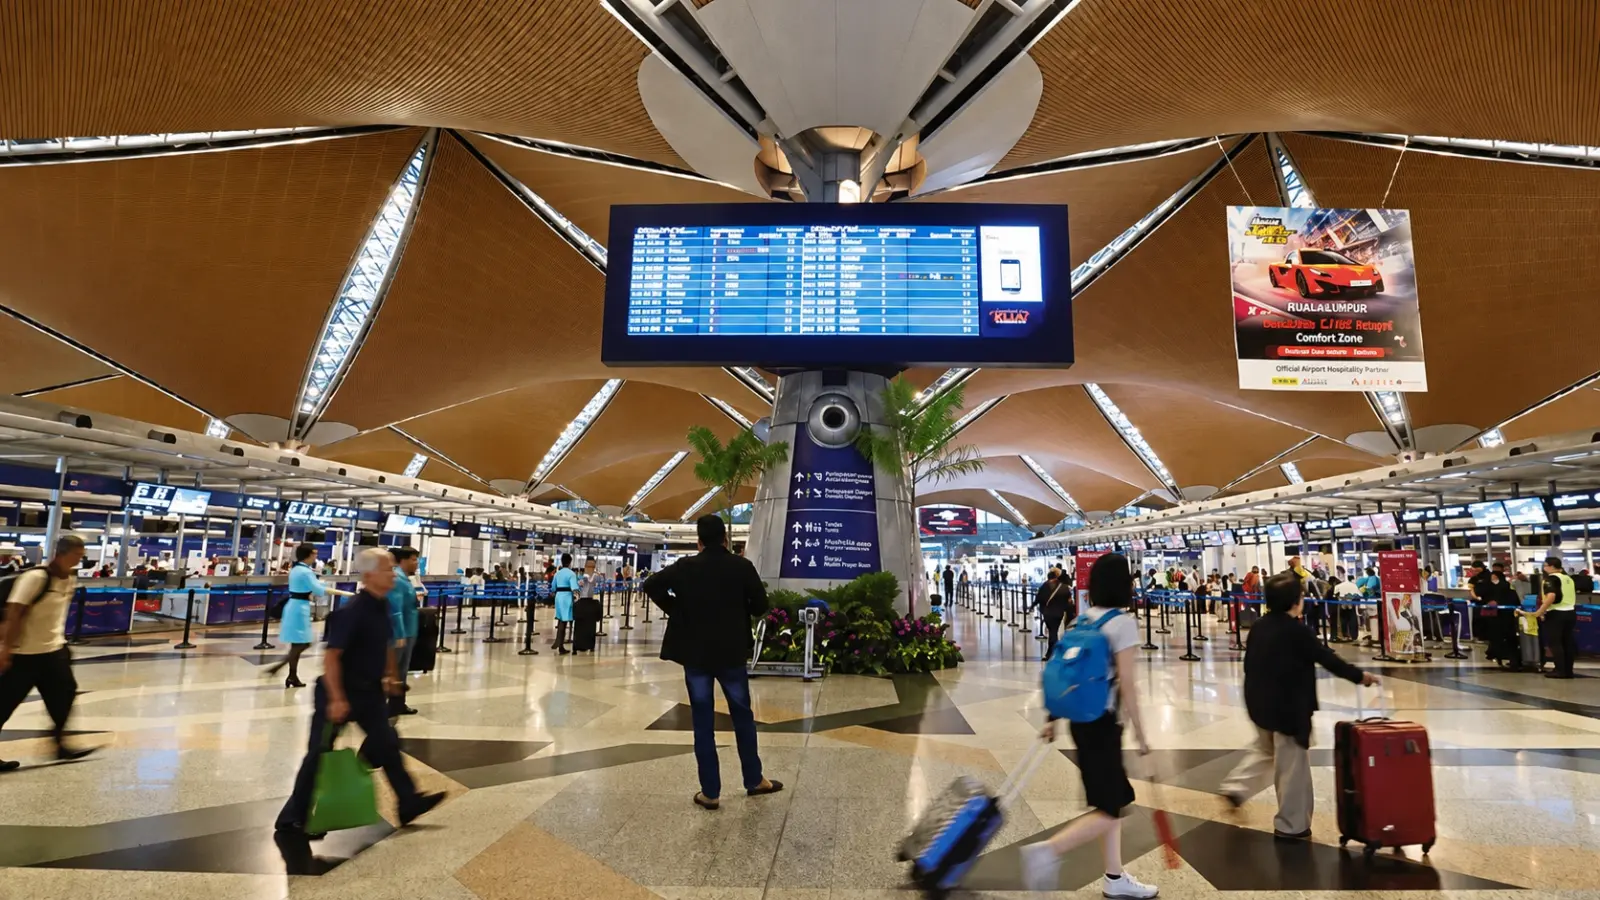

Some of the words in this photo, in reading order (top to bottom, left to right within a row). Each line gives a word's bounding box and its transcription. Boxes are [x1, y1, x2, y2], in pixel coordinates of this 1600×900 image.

[1295, 332, 1335, 343] Comfort
[1337, 333, 1363, 343] Zone
[1275, 365, 1300, 373] Official
[1301, 365, 1326, 374] Airport
[1327, 366, 1363, 375] Hospitality
